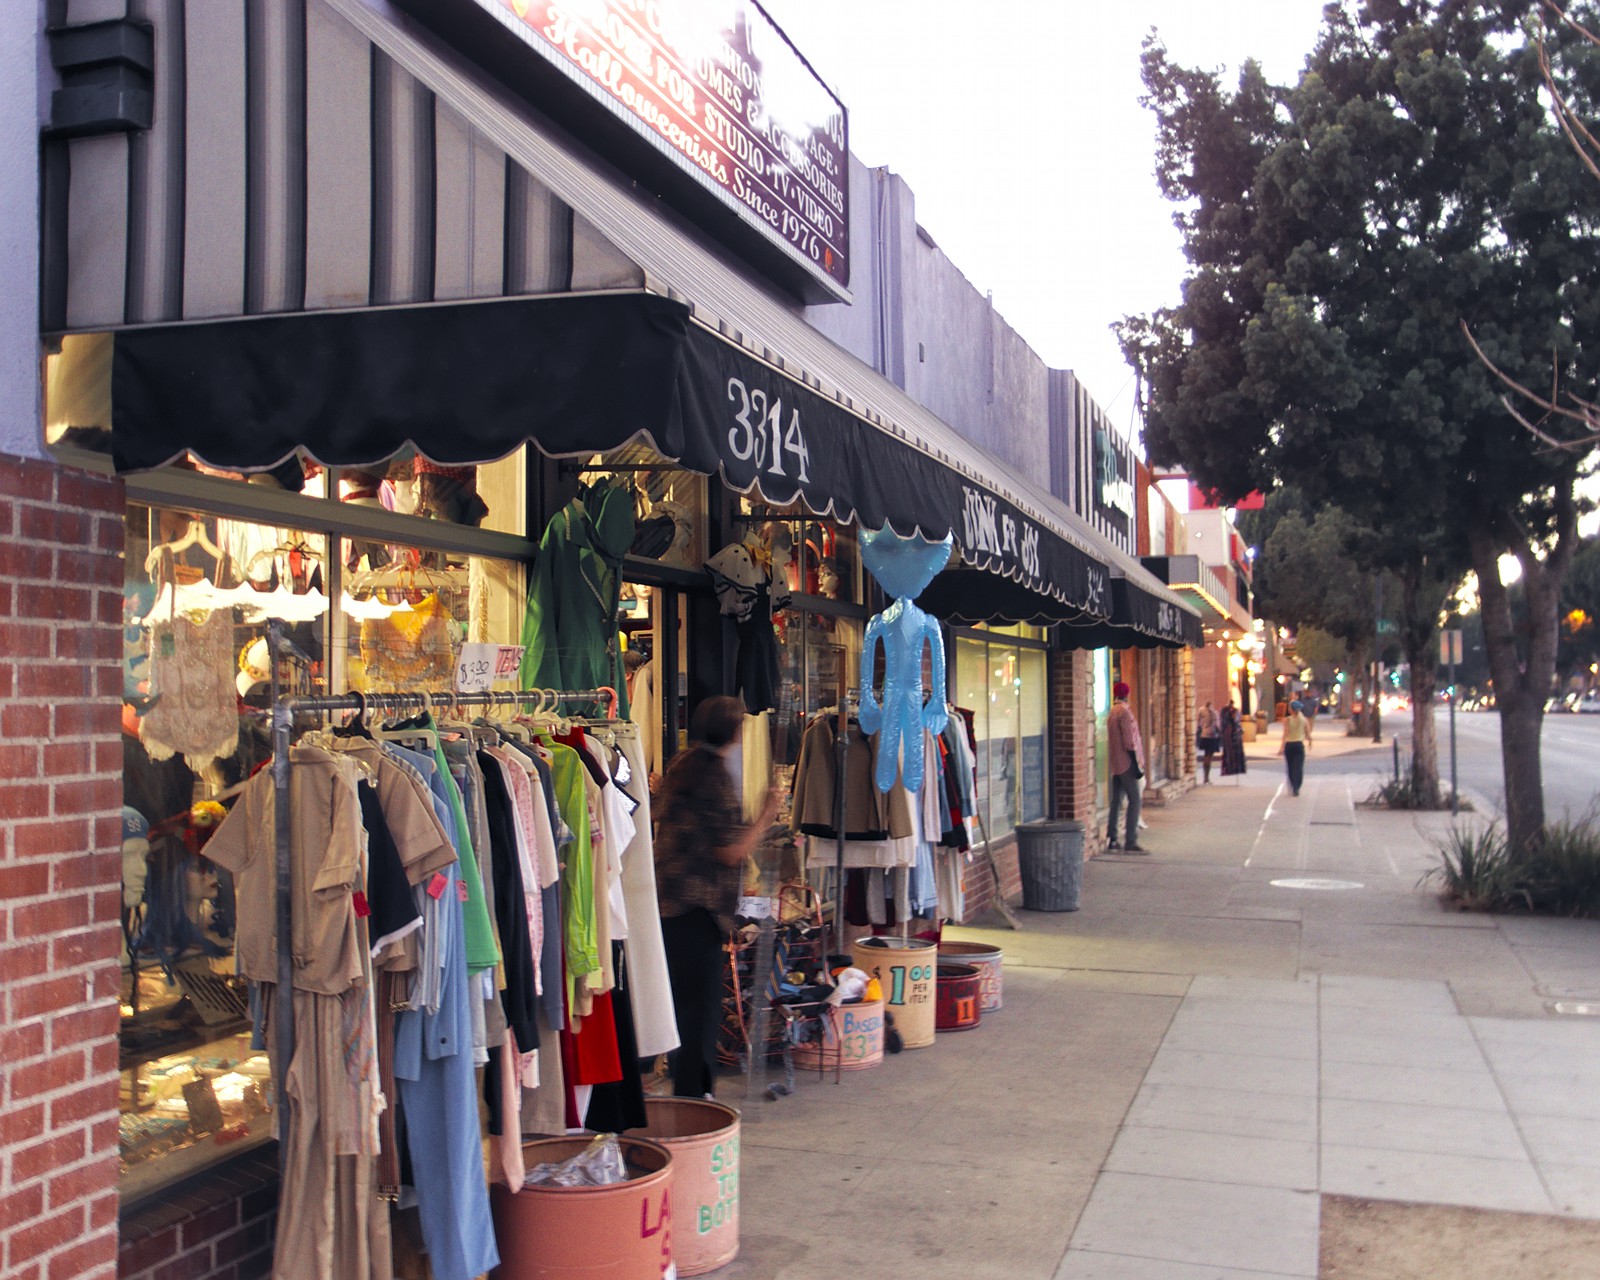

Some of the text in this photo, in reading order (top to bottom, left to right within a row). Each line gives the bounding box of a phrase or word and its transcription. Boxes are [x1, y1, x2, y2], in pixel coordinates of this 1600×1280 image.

[656, 55, 697, 116] FOR
[705, 102, 764, 175] STUDIO
[771, 162, 790, 197] TV
[796, 186, 833, 238] VIDEO
[733, 167, 779, 227] Since
[782, 209, 820, 261] 1976
[727, 376, 811, 485] 3314
[912, 983, 928, 993] PER
